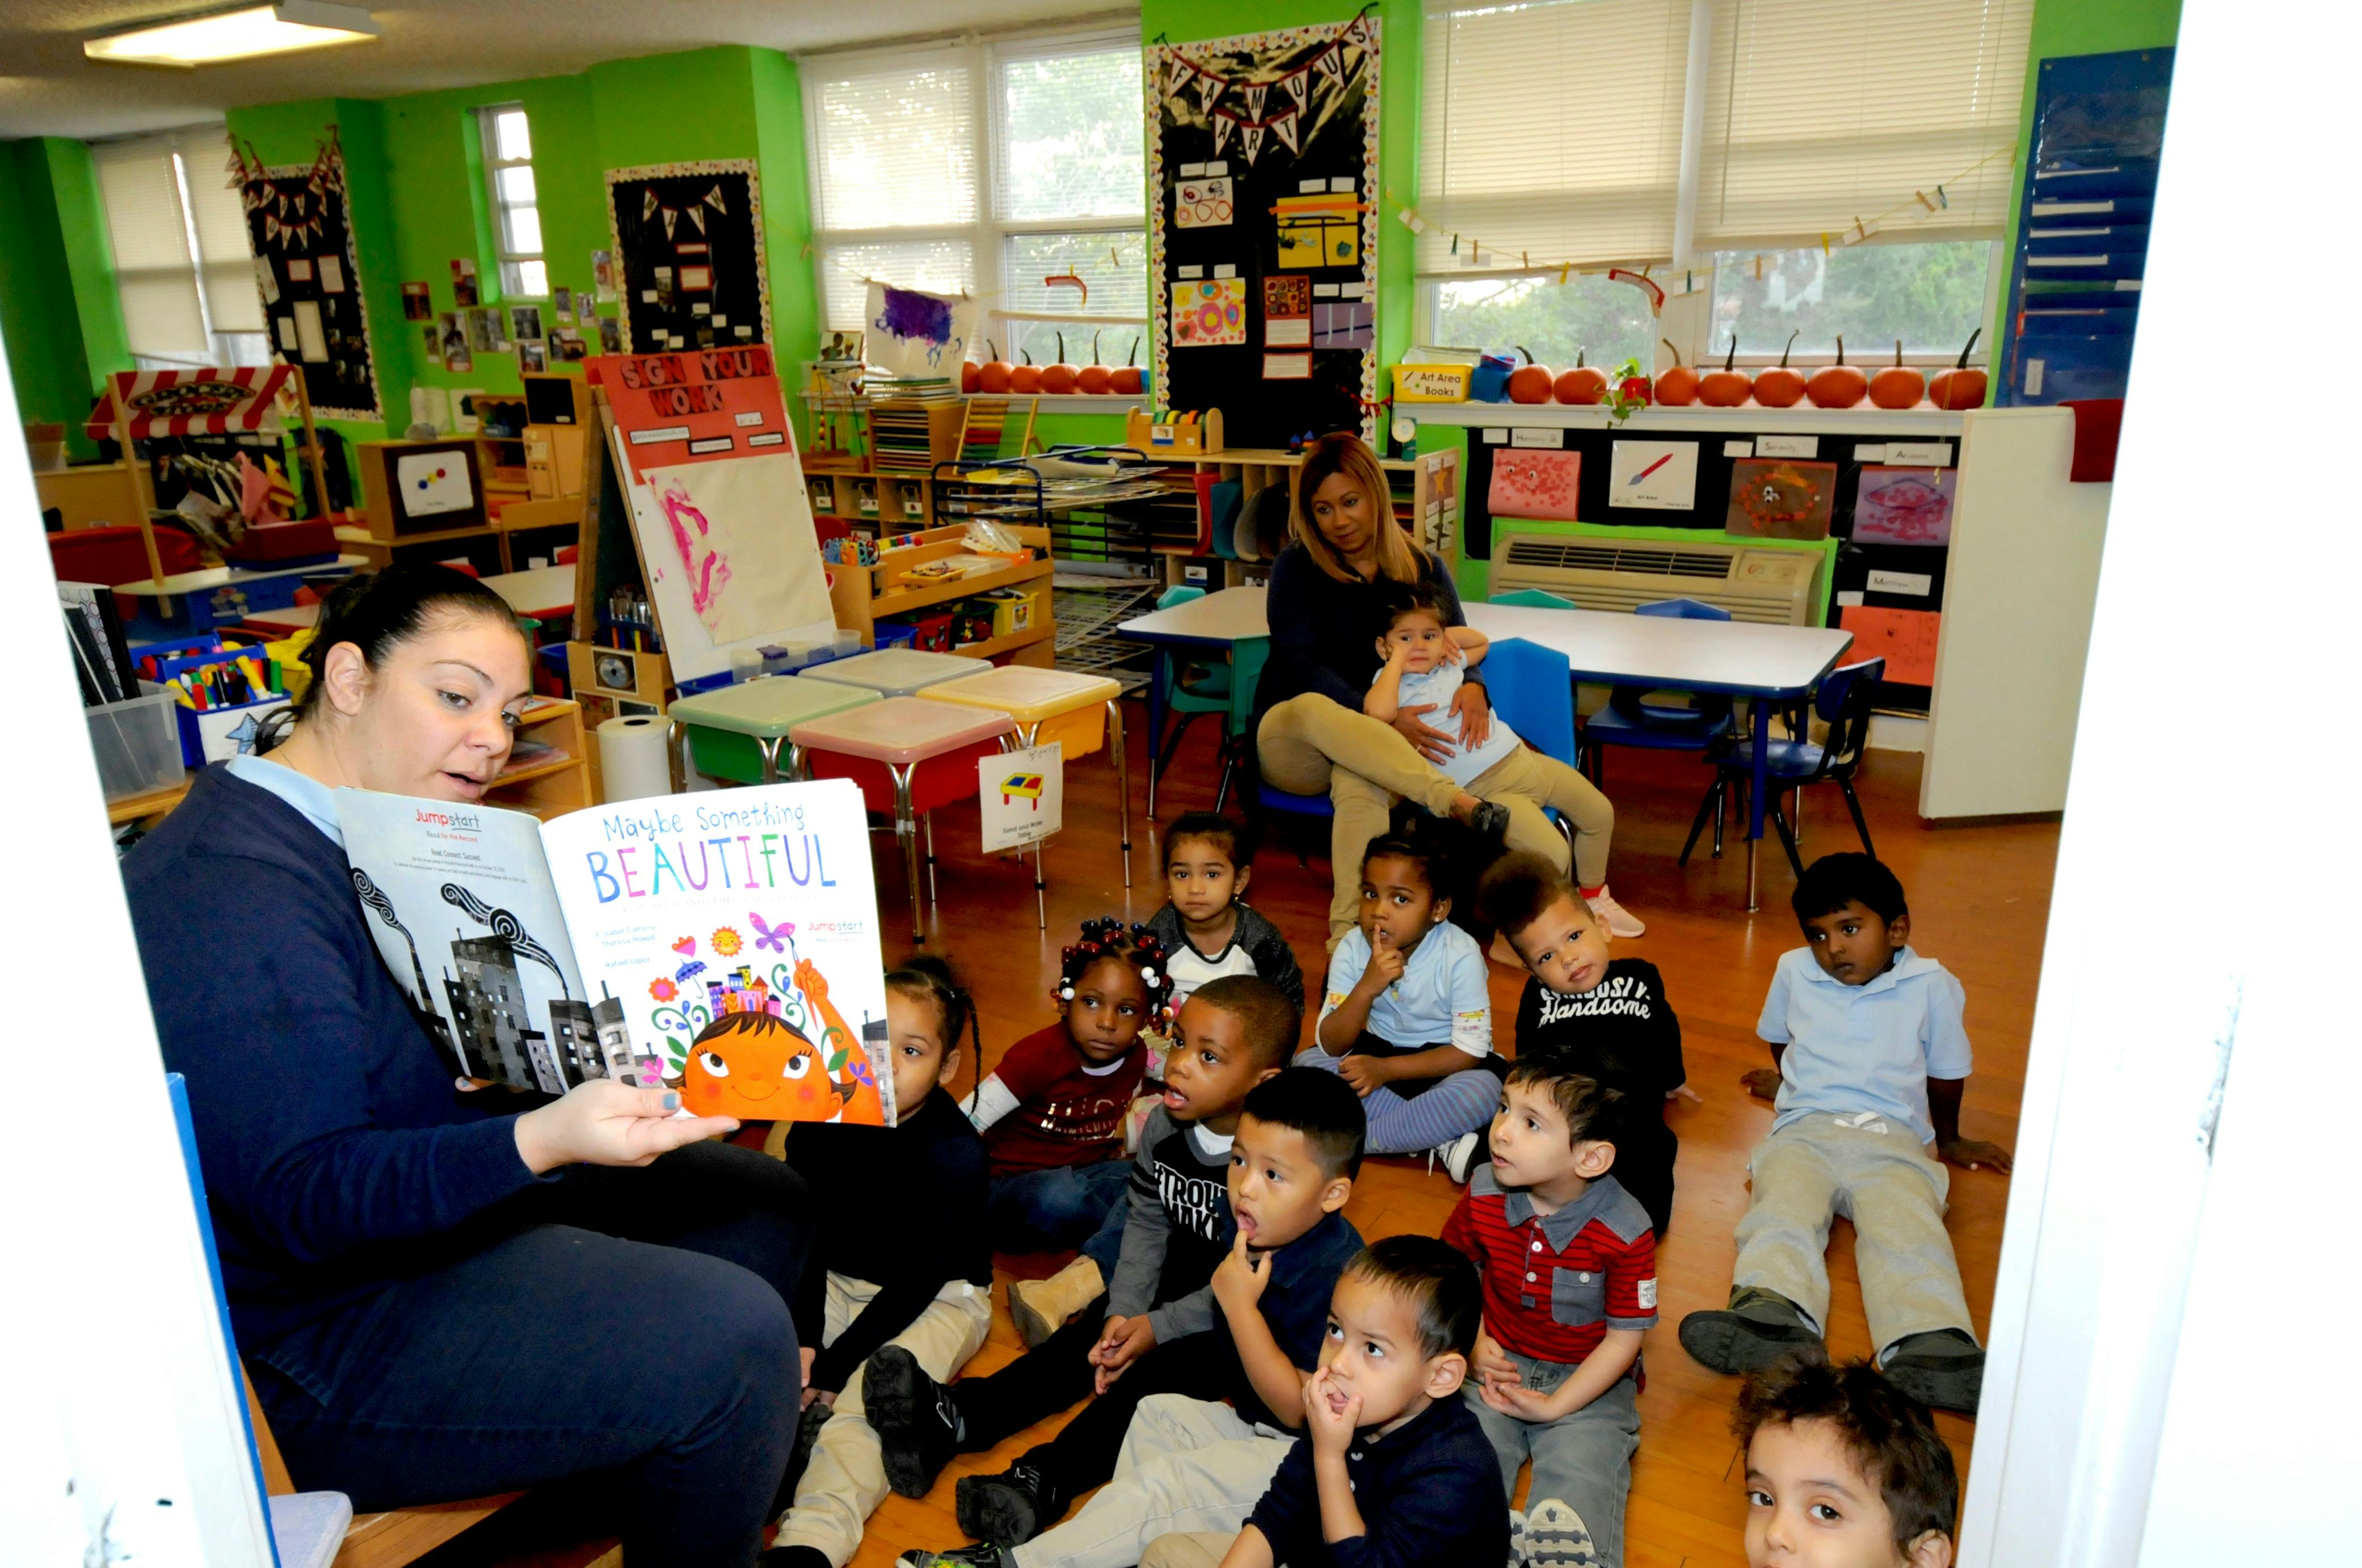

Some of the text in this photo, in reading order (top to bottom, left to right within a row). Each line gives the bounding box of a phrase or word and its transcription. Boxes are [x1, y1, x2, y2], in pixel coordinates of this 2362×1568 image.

[1172, 25, 1366, 109] FAMOUS
[1218, 118, 1293, 150] ART
[621, 349, 771, 389] SIGN YOUR
[1420, 372, 1461, 383] Art Area
[649, 384, 723, 417] WORK
[1425, 386, 1454, 397] Books
[1765, 442, 1796, 453] Serenity
[415, 808, 480, 829] Jumpstart
[603, 802, 805, 841] Maybe Something
[586, 834, 837, 904] BEAUTIFUL
[808, 920, 863, 931] Jumpstart
[601, 938, 631, 947] Theresa
[605, 959, 628, 968] Rafael
[1536, 997, 1651, 1029] Handsome
